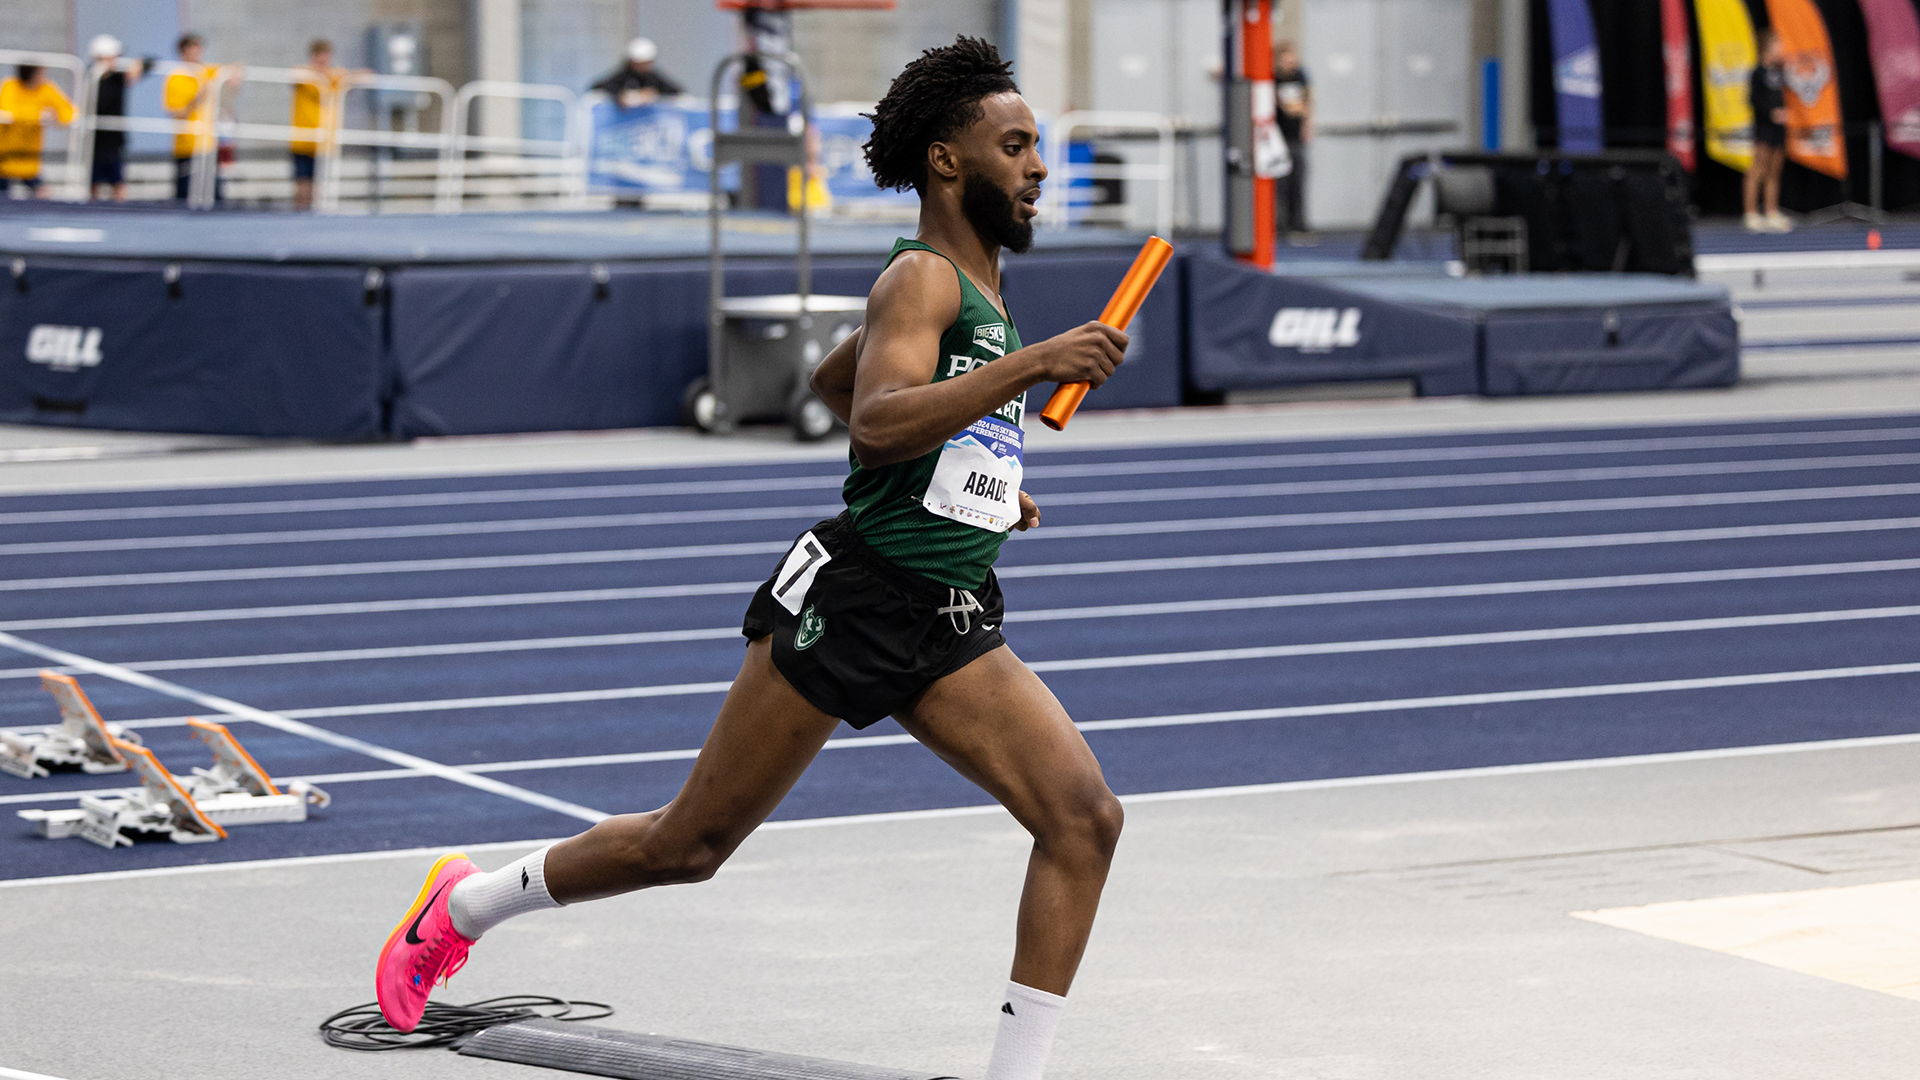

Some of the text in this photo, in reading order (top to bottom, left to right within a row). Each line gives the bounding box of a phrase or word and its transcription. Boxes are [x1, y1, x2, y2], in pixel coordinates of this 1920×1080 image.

[26, 324, 103, 367] GILL
[1269, 307, 1361, 348] GILL
[965, 425, 999, 440] NFERENCE
[963, 471, 1008, 504] ABADE
[776, 540, 823, 598] 7
